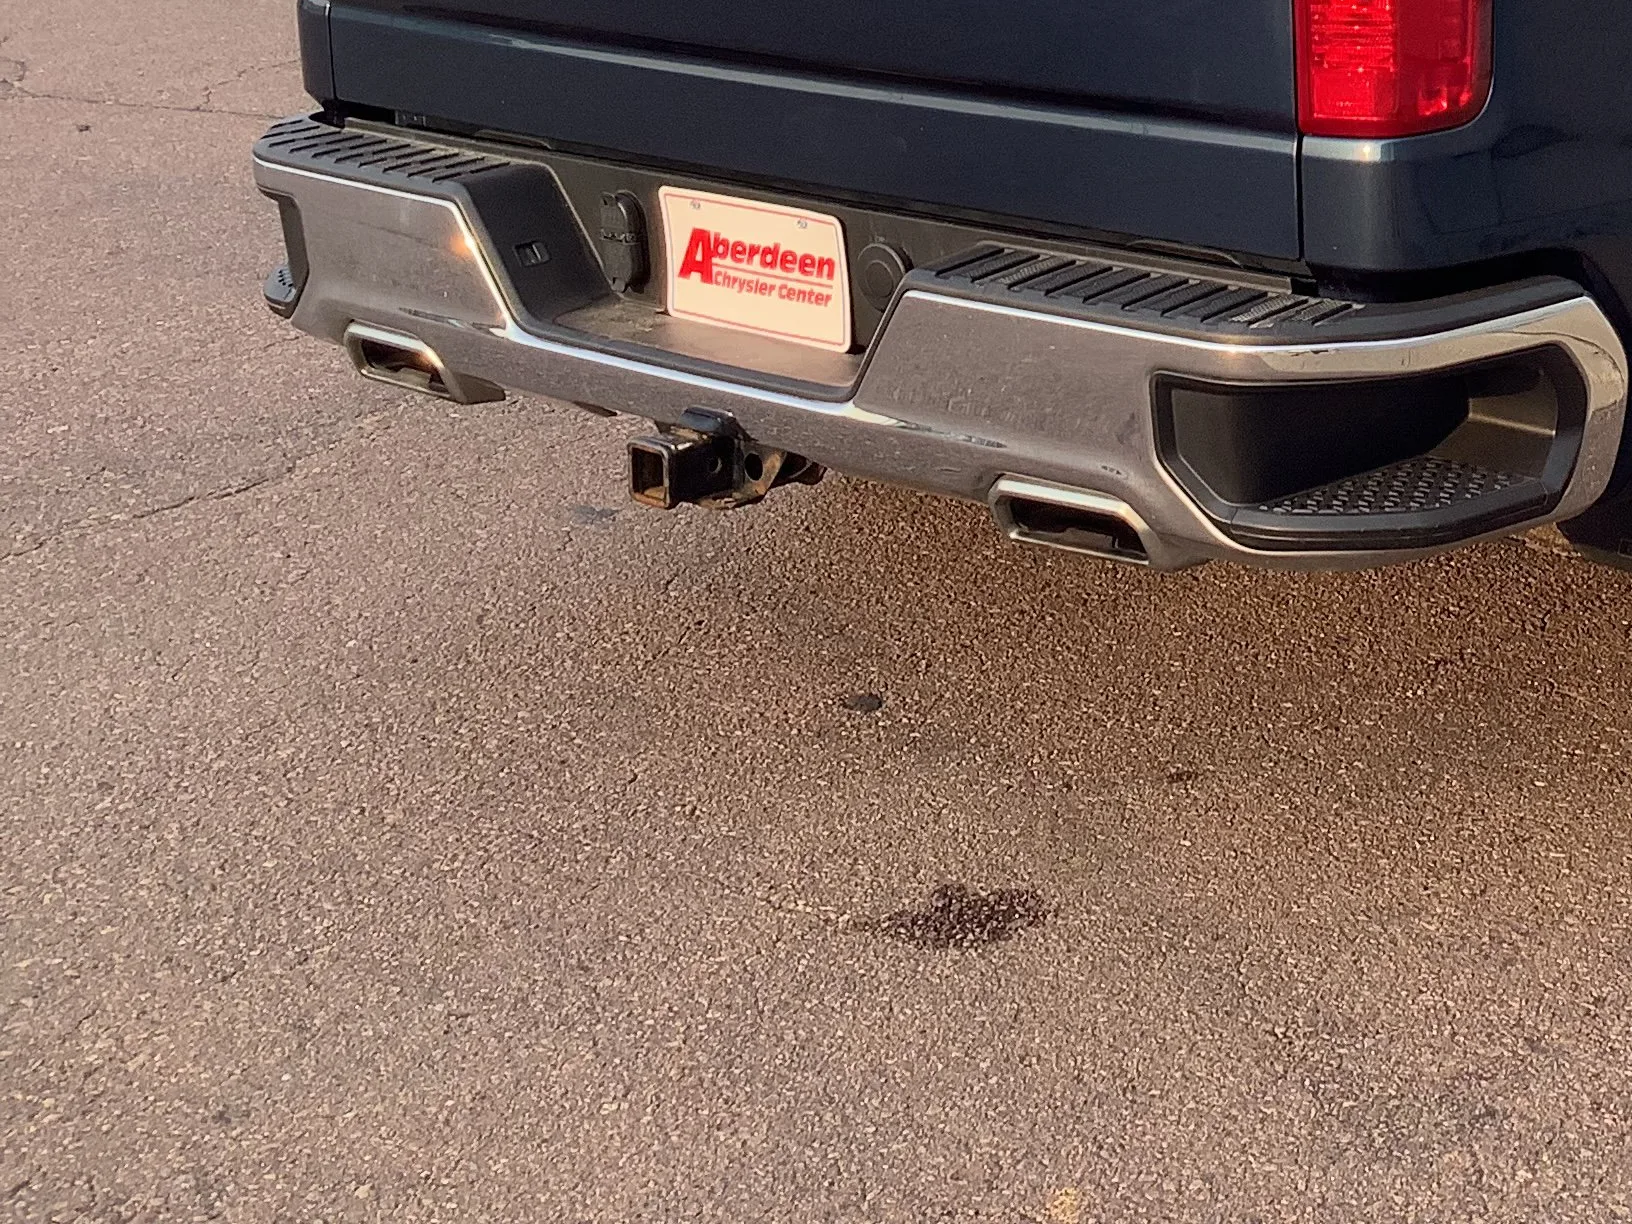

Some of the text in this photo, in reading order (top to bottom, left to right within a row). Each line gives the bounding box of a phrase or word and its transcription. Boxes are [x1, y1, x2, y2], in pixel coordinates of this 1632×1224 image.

[678, 227, 836, 285] Aberdeen
[714, 270, 833, 307] Chrysler Center
